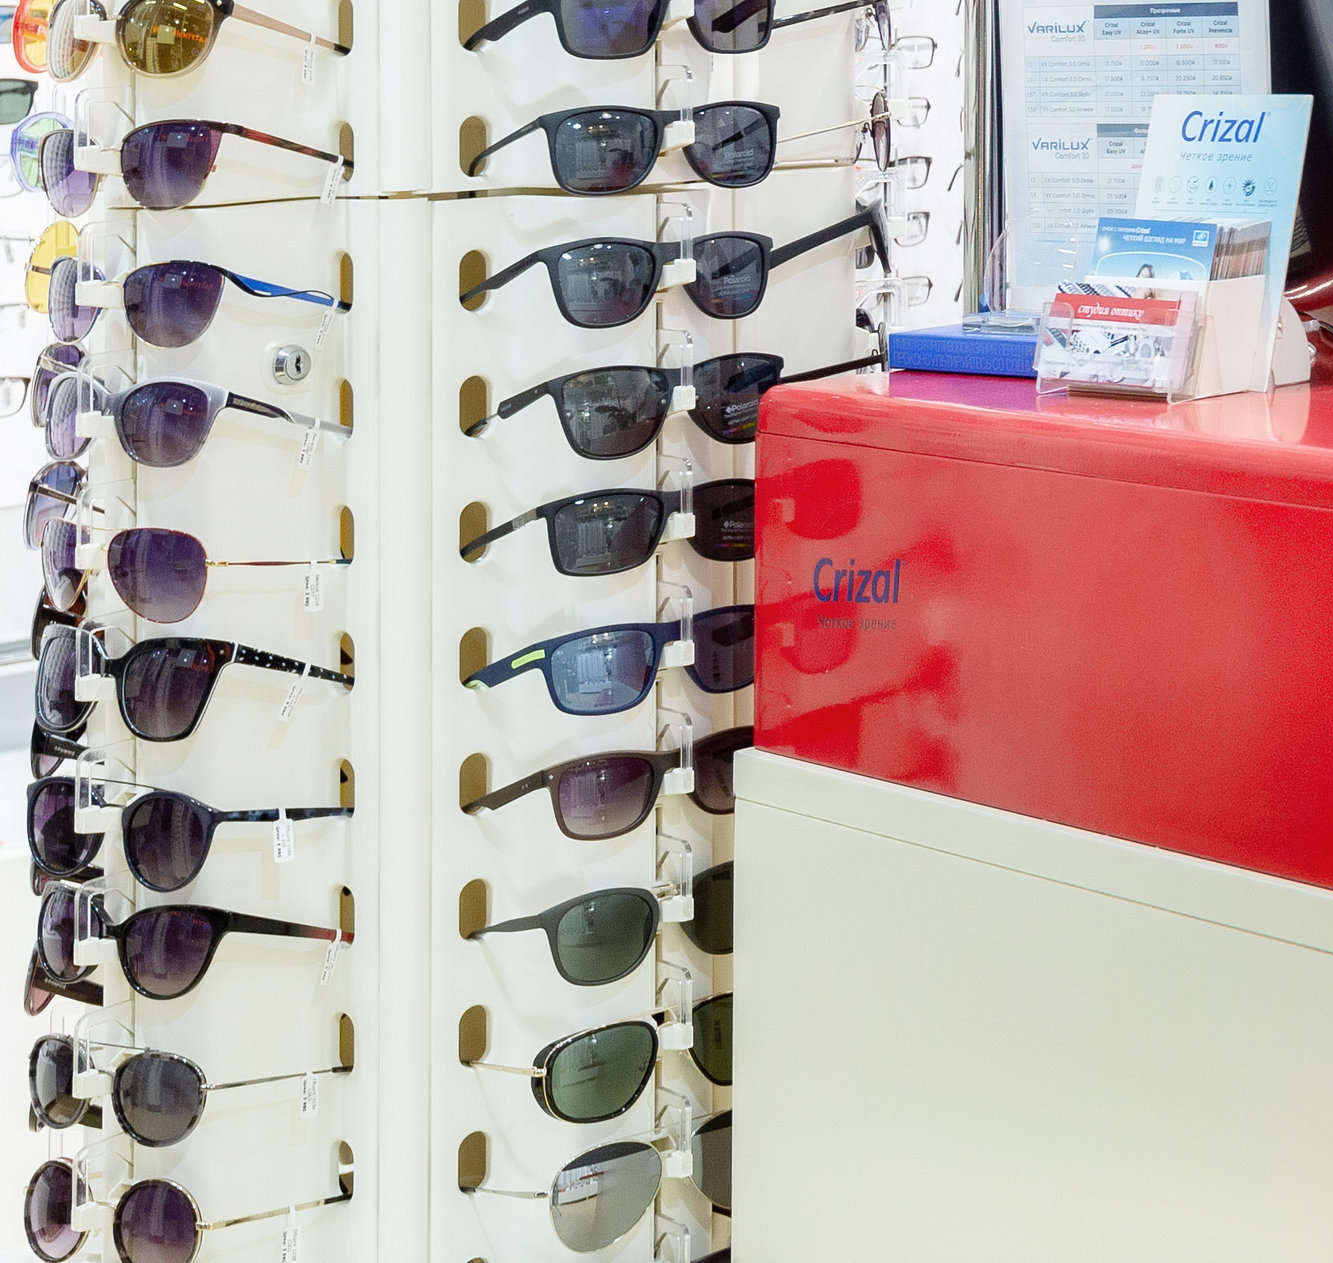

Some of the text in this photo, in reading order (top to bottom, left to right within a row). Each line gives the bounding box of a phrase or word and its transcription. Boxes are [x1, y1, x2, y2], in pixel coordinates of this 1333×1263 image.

[1181, 110, 1267, 144] Crizal
[1179, 151, 1253, 163] Четкое зрение
[813, 557, 902, 604] Crizal
[817, 615, 897, 630] Четкое зрение
